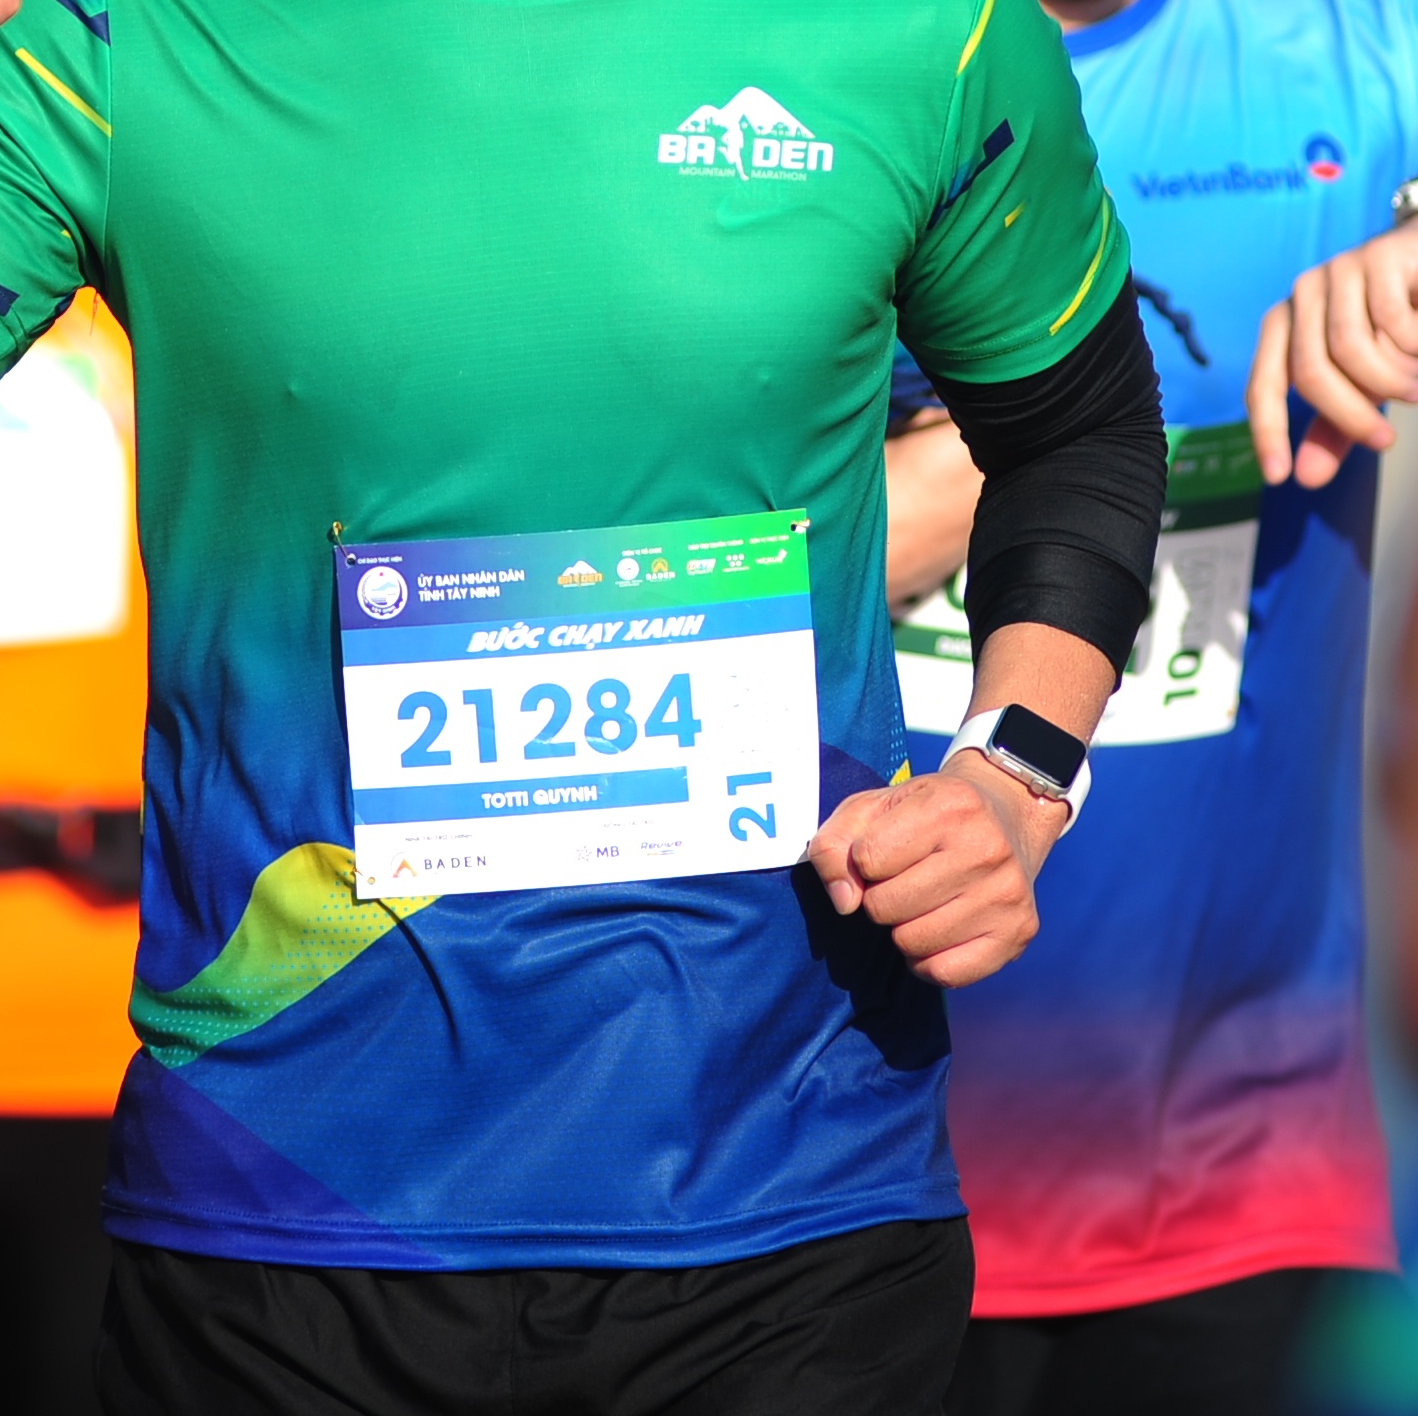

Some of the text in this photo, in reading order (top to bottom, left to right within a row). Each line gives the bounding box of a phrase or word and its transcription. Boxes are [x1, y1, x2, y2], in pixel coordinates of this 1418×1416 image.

[679, 166, 807, 182] MOUNTAIN MARATHON
[435, 573, 460, 587] BAN
[462, 570, 497, 586] NHÂN
[499, 568, 526, 584] DÂN
[446, 586, 467, 601] TÂY
[469, 585, 501, 599] NINH
[466, 614, 705, 653] BƯỚC CHẠY XANH
[396, 672, 703, 769] 21284
[481, 785, 598, 810] TOTTI QUYNH
[726, 771, 777, 842] 21
[596, 845, 620, 858] MB
[424, 856, 487, 870] BADEN
